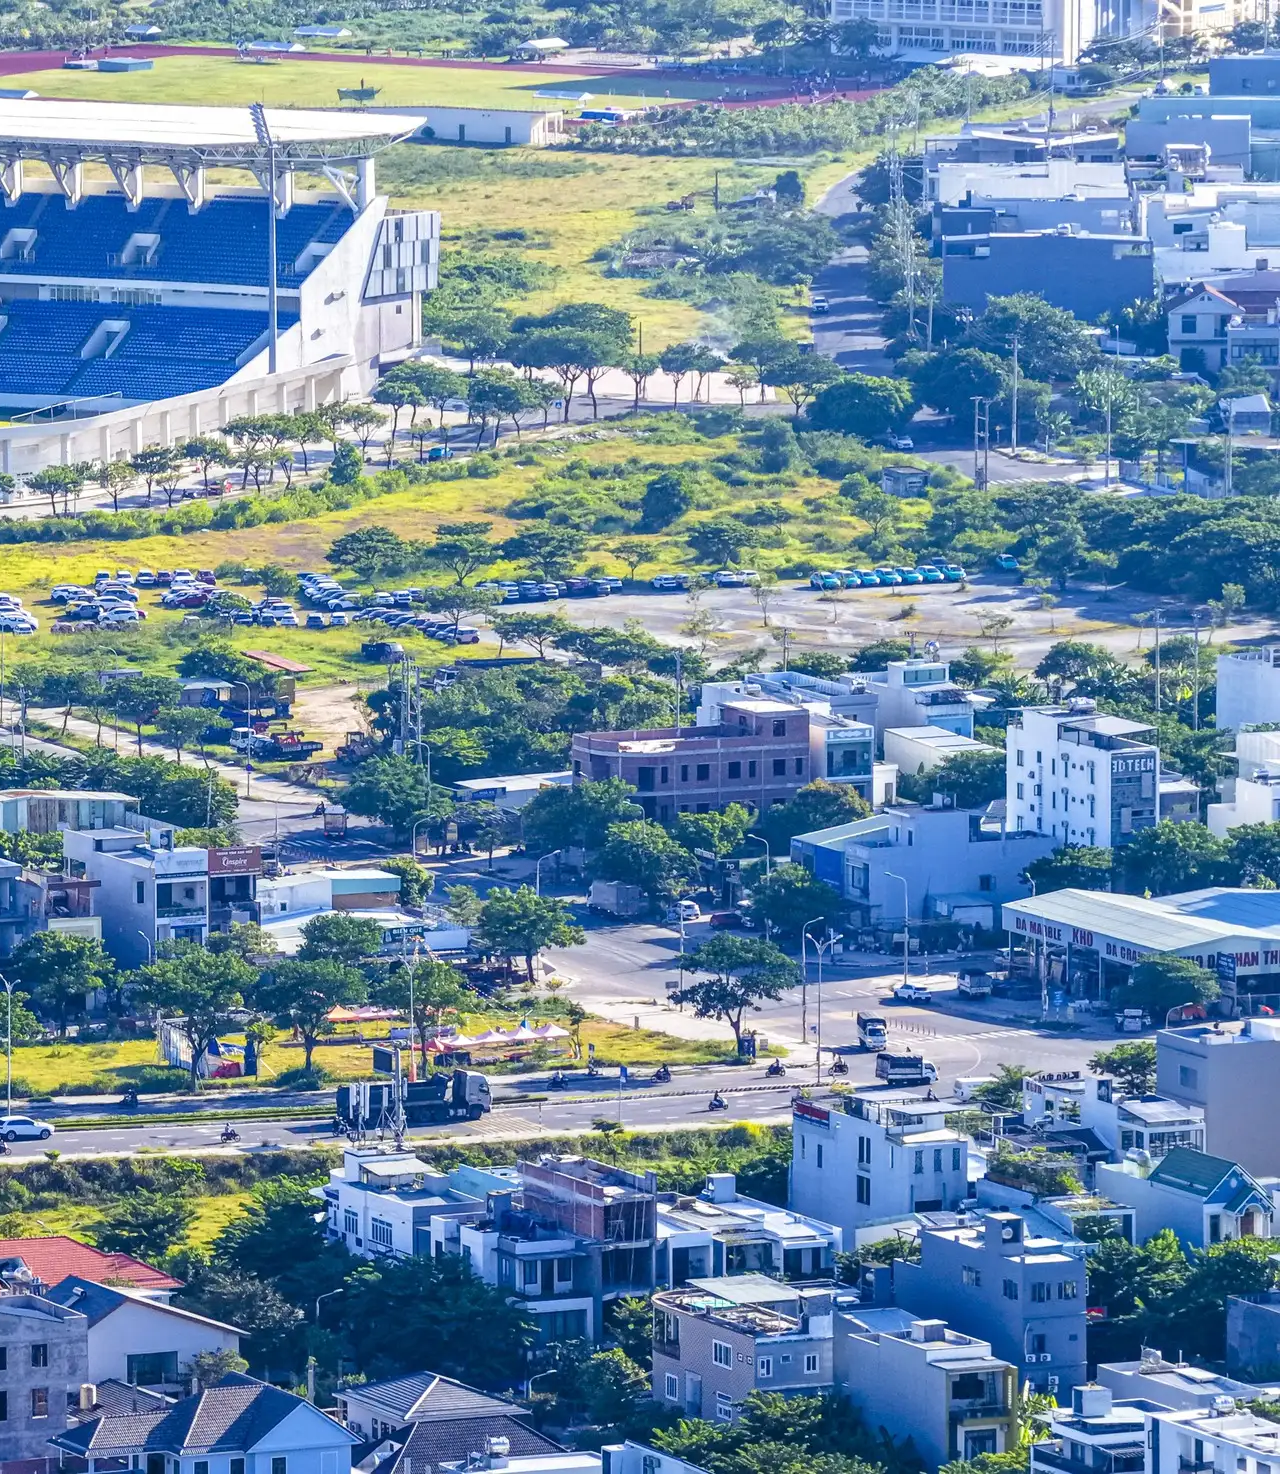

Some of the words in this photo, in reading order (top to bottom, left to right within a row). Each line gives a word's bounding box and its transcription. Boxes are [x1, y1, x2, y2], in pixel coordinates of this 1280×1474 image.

[1072, 928, 1094, 947] KHO
[1229, 951, 1259, 967] HAN
[1263, 950, 1280, 965] TH
